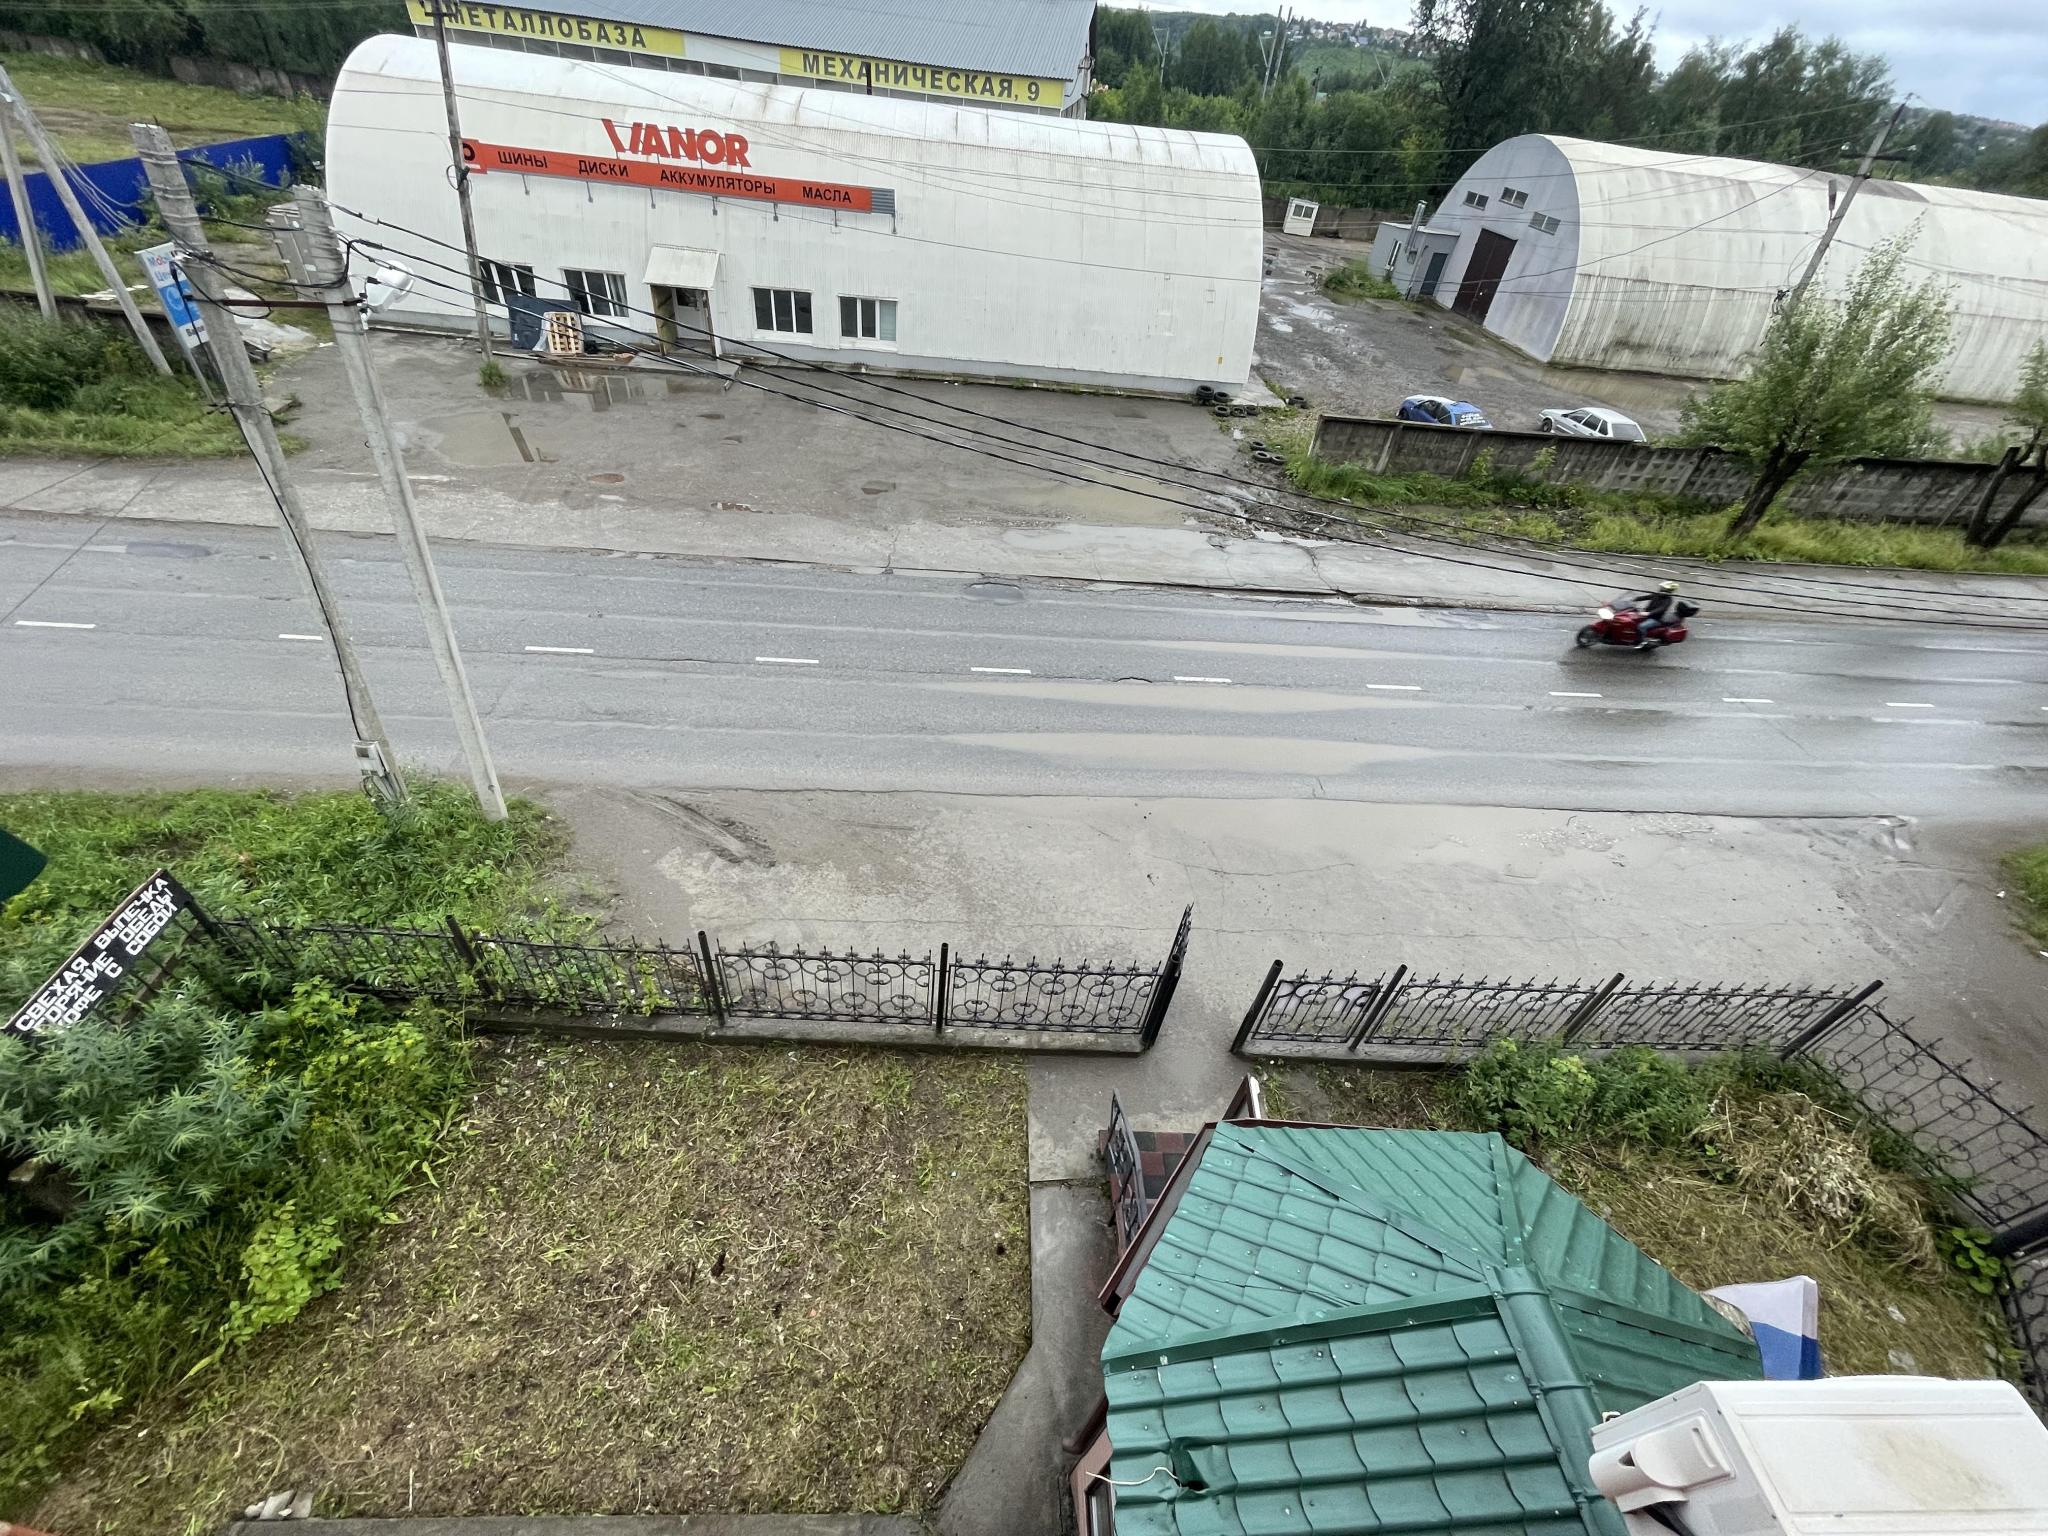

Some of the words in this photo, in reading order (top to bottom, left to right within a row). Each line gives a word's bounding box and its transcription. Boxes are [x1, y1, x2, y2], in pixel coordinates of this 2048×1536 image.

[444, 2, 647, 48] МЕТАЛЛОБАЗА
[1027, 81, 1041, 101] 9
[498, 151, 548, 168] ШИНЫ
[578, 159, 629, 177] ДИСКИ
[660, 169, 776, 195] АККУМУЛЯТОРЫ
[802, 186, 852, 203] МАСЛА
[118, 887, 173, 943] ОБЕДЫ
[15, 956, 90, 1031] СВЕЖАЯ
[93, 877, 168, 949] ВЫПЕЧКА
[104, 962, 123, 978] С
